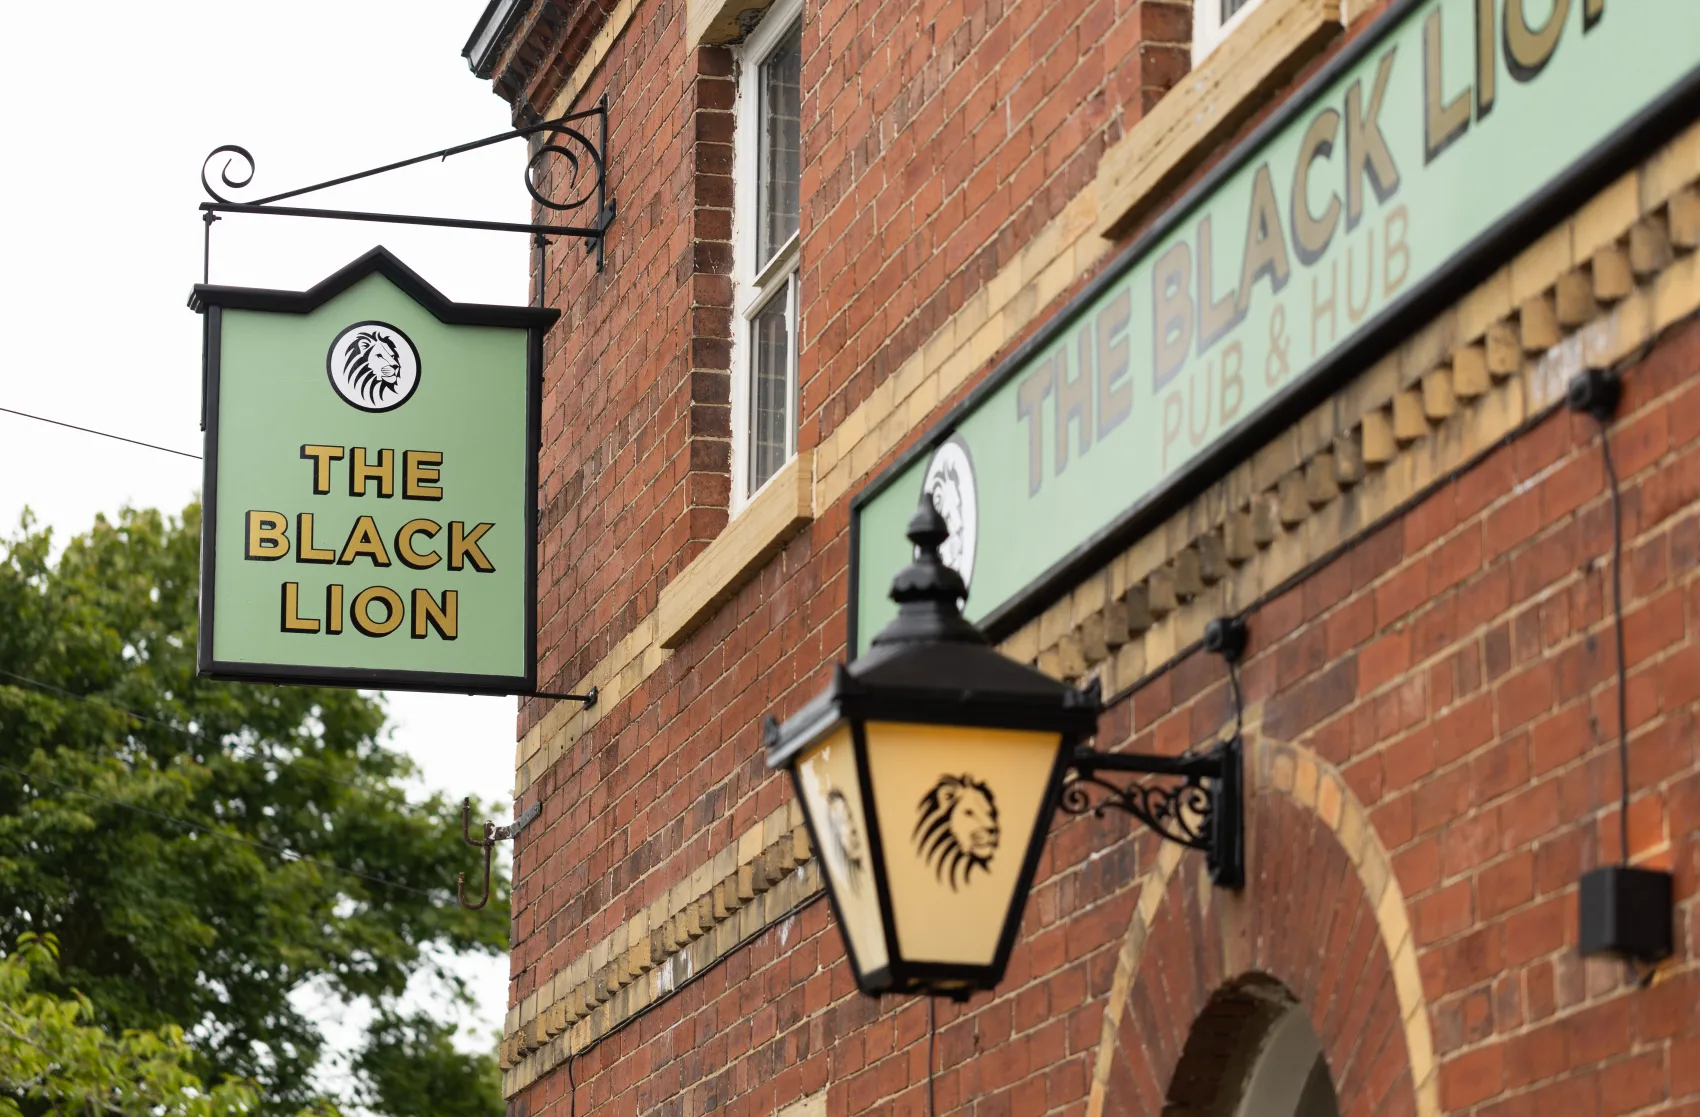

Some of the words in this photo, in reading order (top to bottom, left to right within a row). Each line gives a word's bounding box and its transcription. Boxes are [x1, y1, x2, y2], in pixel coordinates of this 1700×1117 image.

[1017, 286, 1133, 498] THE
[1151, 44, 1400, 395] BLACK
[1423, 0, 1606, 168] LIO
[1162, 341, 1244, 473] PUB
[1265, 303, 1291, 391] &
[1311, 204, 1410, 357] HUB
[300, 444, 443, 501] THE
[245, 510, 496, 573] BLACK
[281, 582, 458, 641] LION
